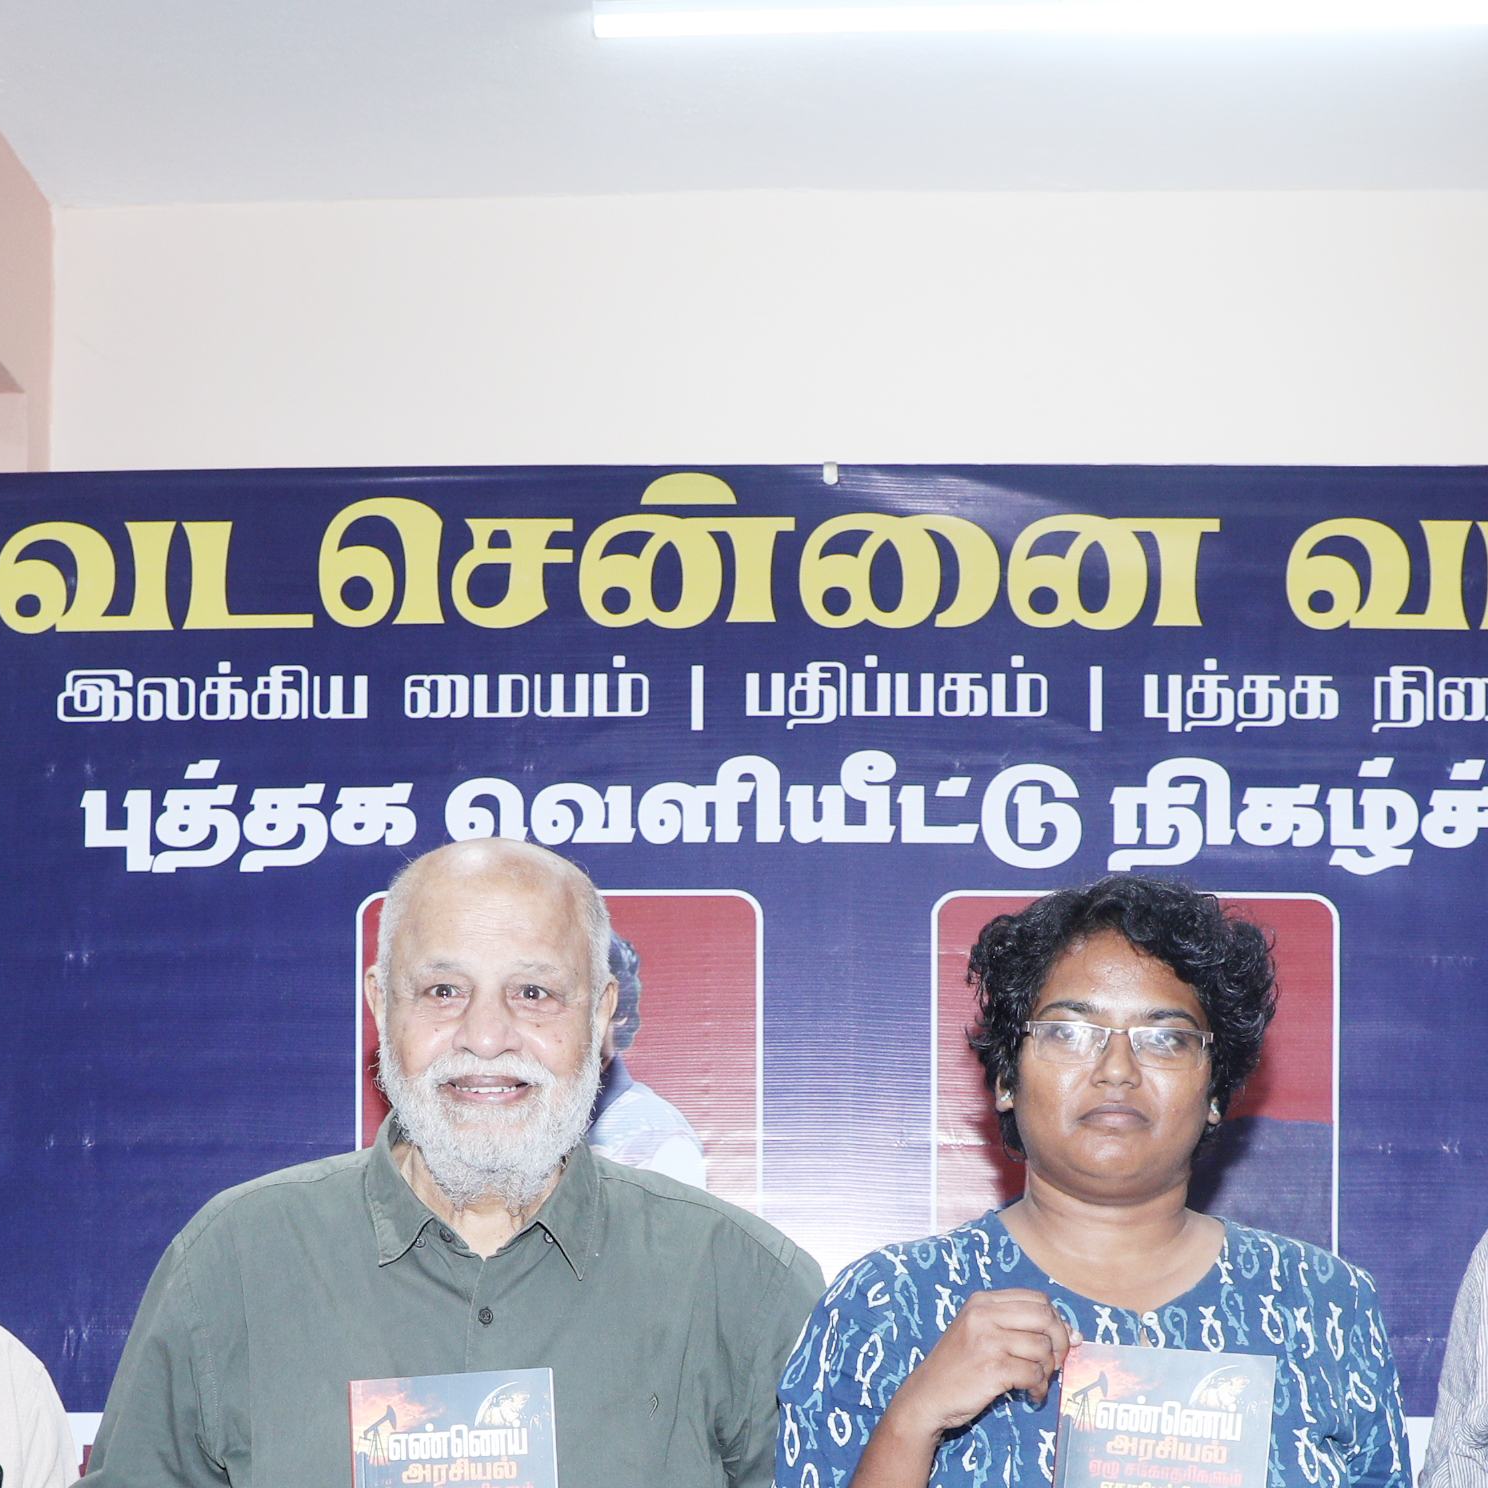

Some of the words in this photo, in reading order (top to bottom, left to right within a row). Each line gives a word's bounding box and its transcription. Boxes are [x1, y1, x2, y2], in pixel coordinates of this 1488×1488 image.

[56, 664, 369, 723] இலக்கிய
[404, 656, 649, 720] மையம்
[746, 655, 1047, 730] பதிப்பகம்
[1144, 663, 1340, 732] புத்தக
[79, 761, 417, 874] புத்தக
[443, 750, 1083, 869] வெளியீட்டு
[1095, 1395, 1243, 1442] எண்ணெய்
[388, 1419, 528, 1461] எண்ணெய்
[1106, 1434, 1229, 1464] அரசியல்
[401, 1456, 518, 1485] அரசியல்
[1088, 1458, 1119, 1479] ஏழு
